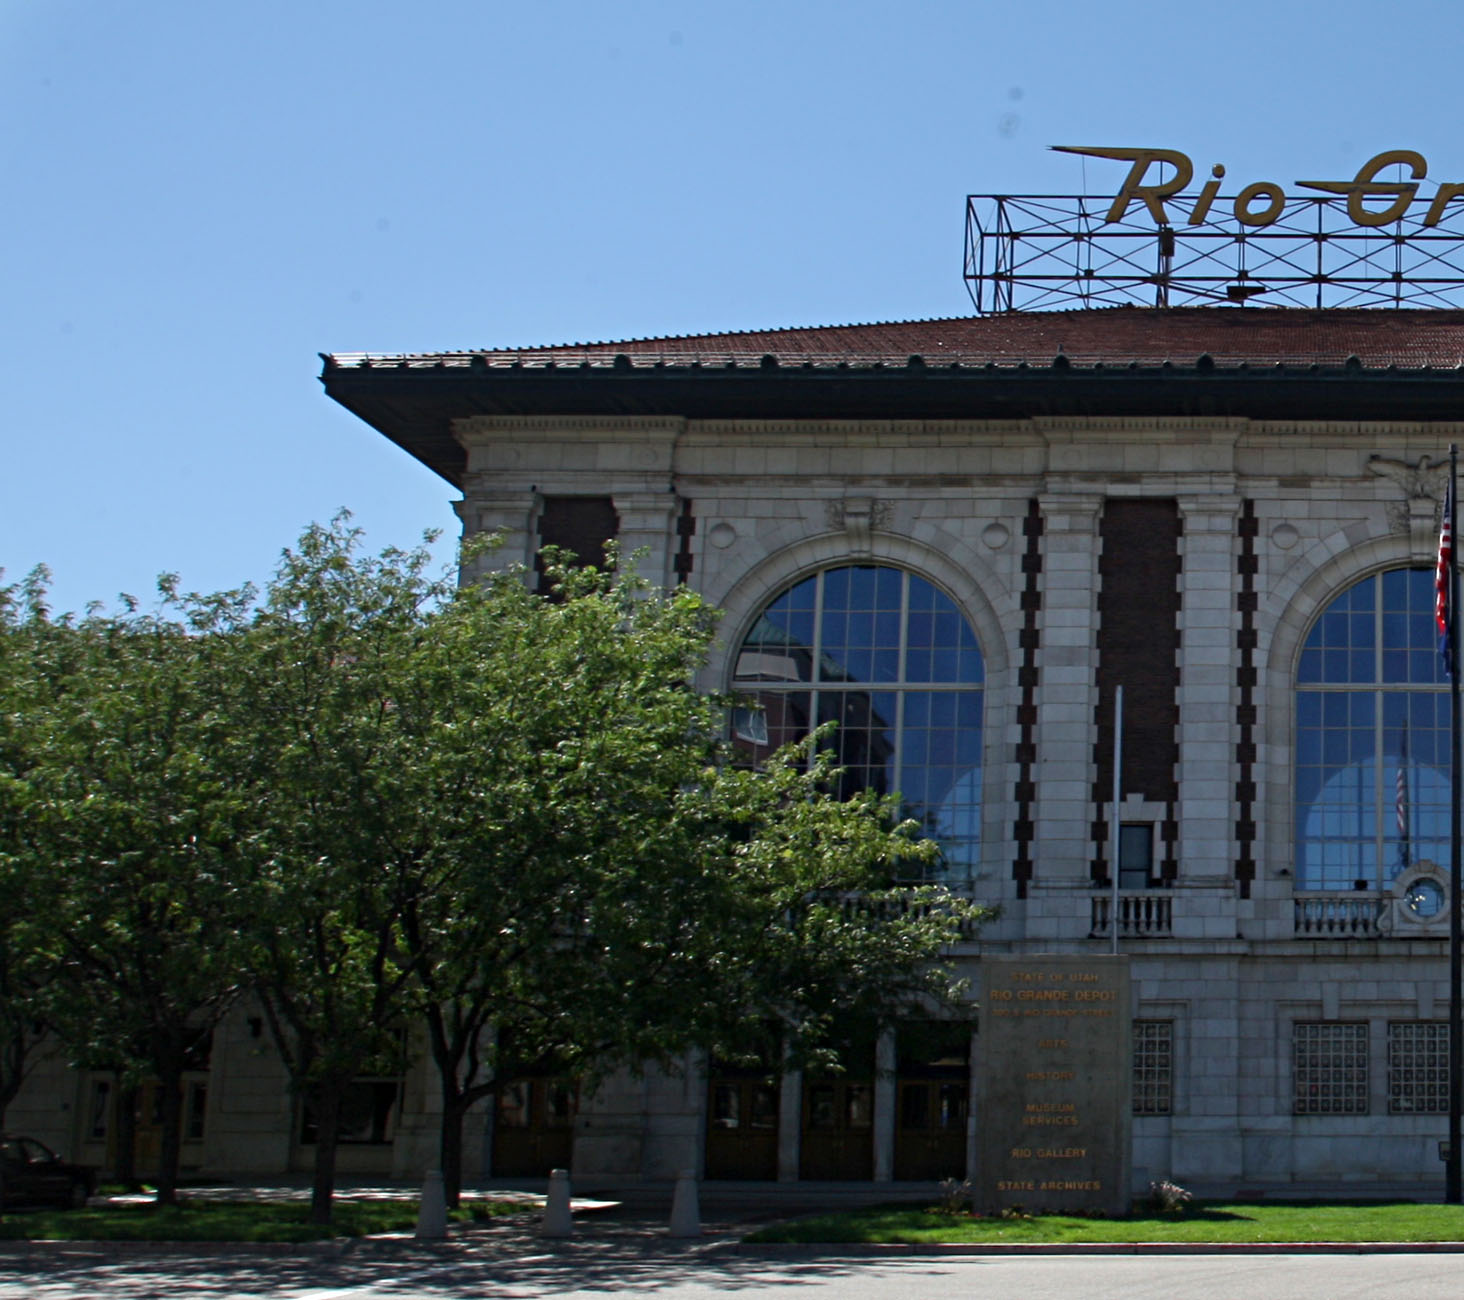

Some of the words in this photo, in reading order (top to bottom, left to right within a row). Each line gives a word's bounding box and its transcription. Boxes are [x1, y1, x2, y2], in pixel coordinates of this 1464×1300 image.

[1046, 145, 1286, 226] Rio
[1011, 972, 1044, 982] STATE
[1050, 972, 1064, 982] OF
[1070, 973, 1097, 983] UTAH
[990, 990, 1012, 1001] RIO
[1017, 990, 1069, 1001] GRANDE
[1075, 990, 1116, 1001] DEPOT
[1025, 1072, 1076, 1081] HISTORY
[1025, 1103, 1075, 1113] MUSEUM
[1022, 1115, 1078, 1126] SERVICES
[1011, 1147, 1031, 1158] RIO
[1036, 1147, 1087, 1158] GALLERY
[997, 1180, 1035, 1191] STATE
[1040, 1180, 1101, 1191] ARCHIVES
